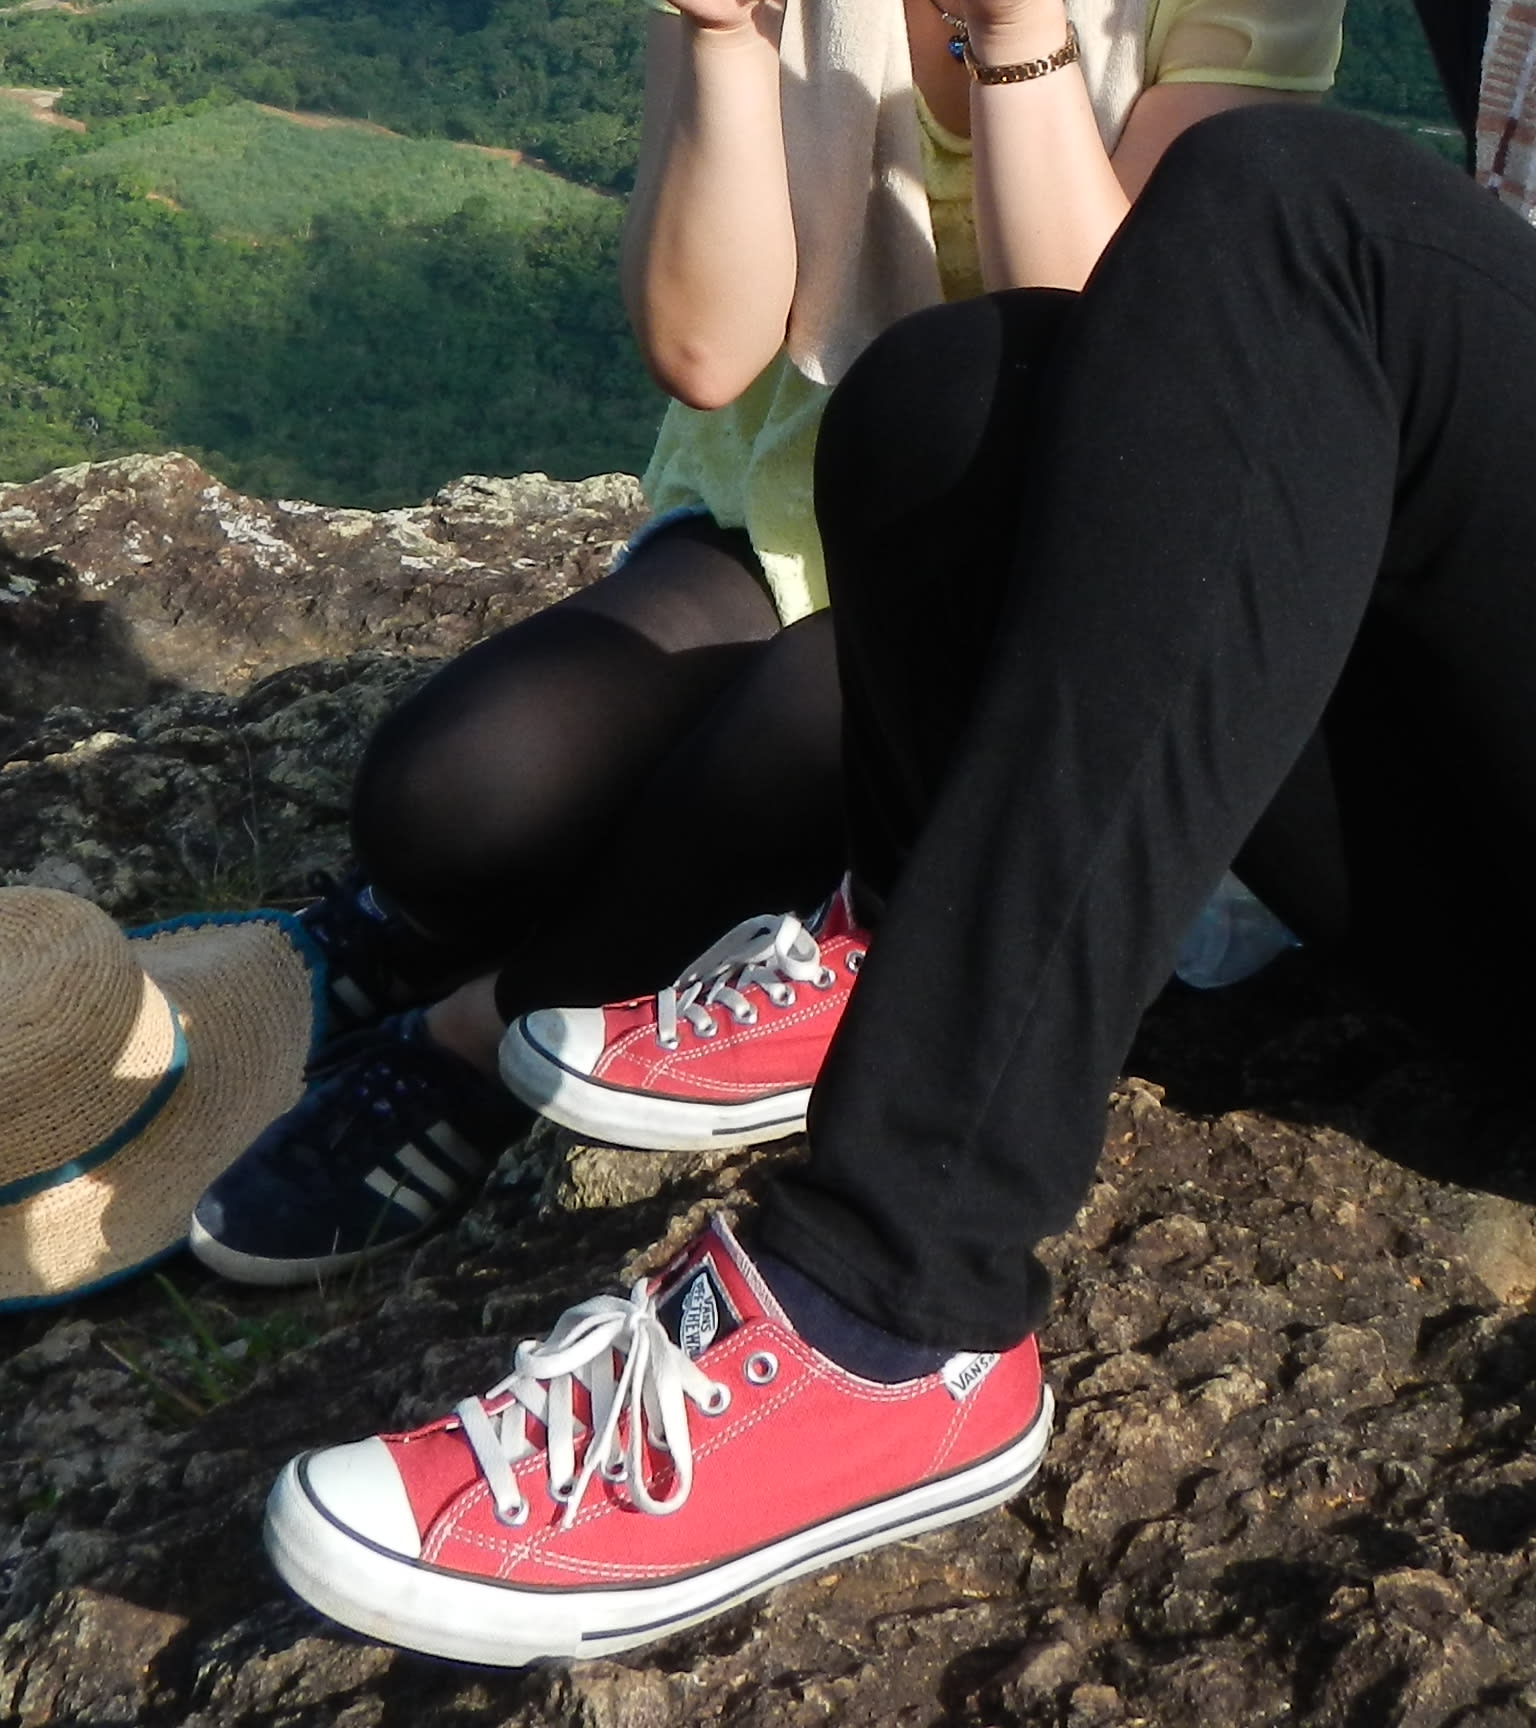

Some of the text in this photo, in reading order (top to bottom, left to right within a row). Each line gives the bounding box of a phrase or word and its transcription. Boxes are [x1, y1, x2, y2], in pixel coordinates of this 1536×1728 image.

[686, 1303, 702, 1332] THE
[701, 1295, 716, 1332] VANS
[951, 1357, 989, 1391] VANS
